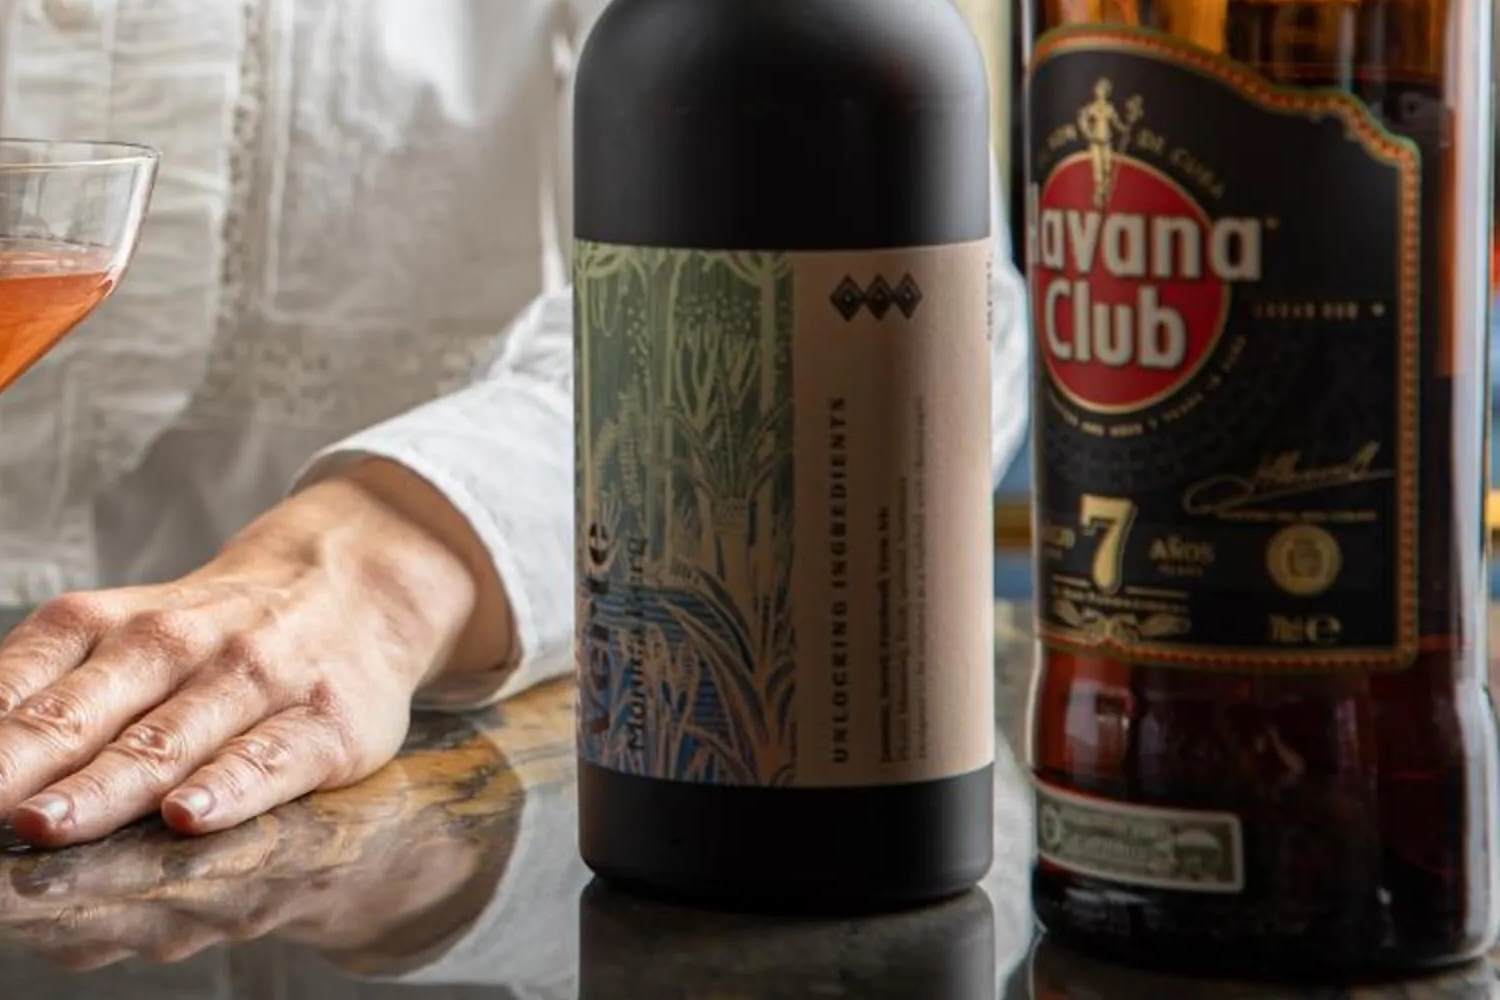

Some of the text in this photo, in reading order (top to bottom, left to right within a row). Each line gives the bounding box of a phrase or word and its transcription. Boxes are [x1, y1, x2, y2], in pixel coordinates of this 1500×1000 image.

[1044, 280, 1187, 369] Club
[827, 396, 849, 764] UNLOCKING INGREDIENTS
[1080, 493, 1138, 596] 7
